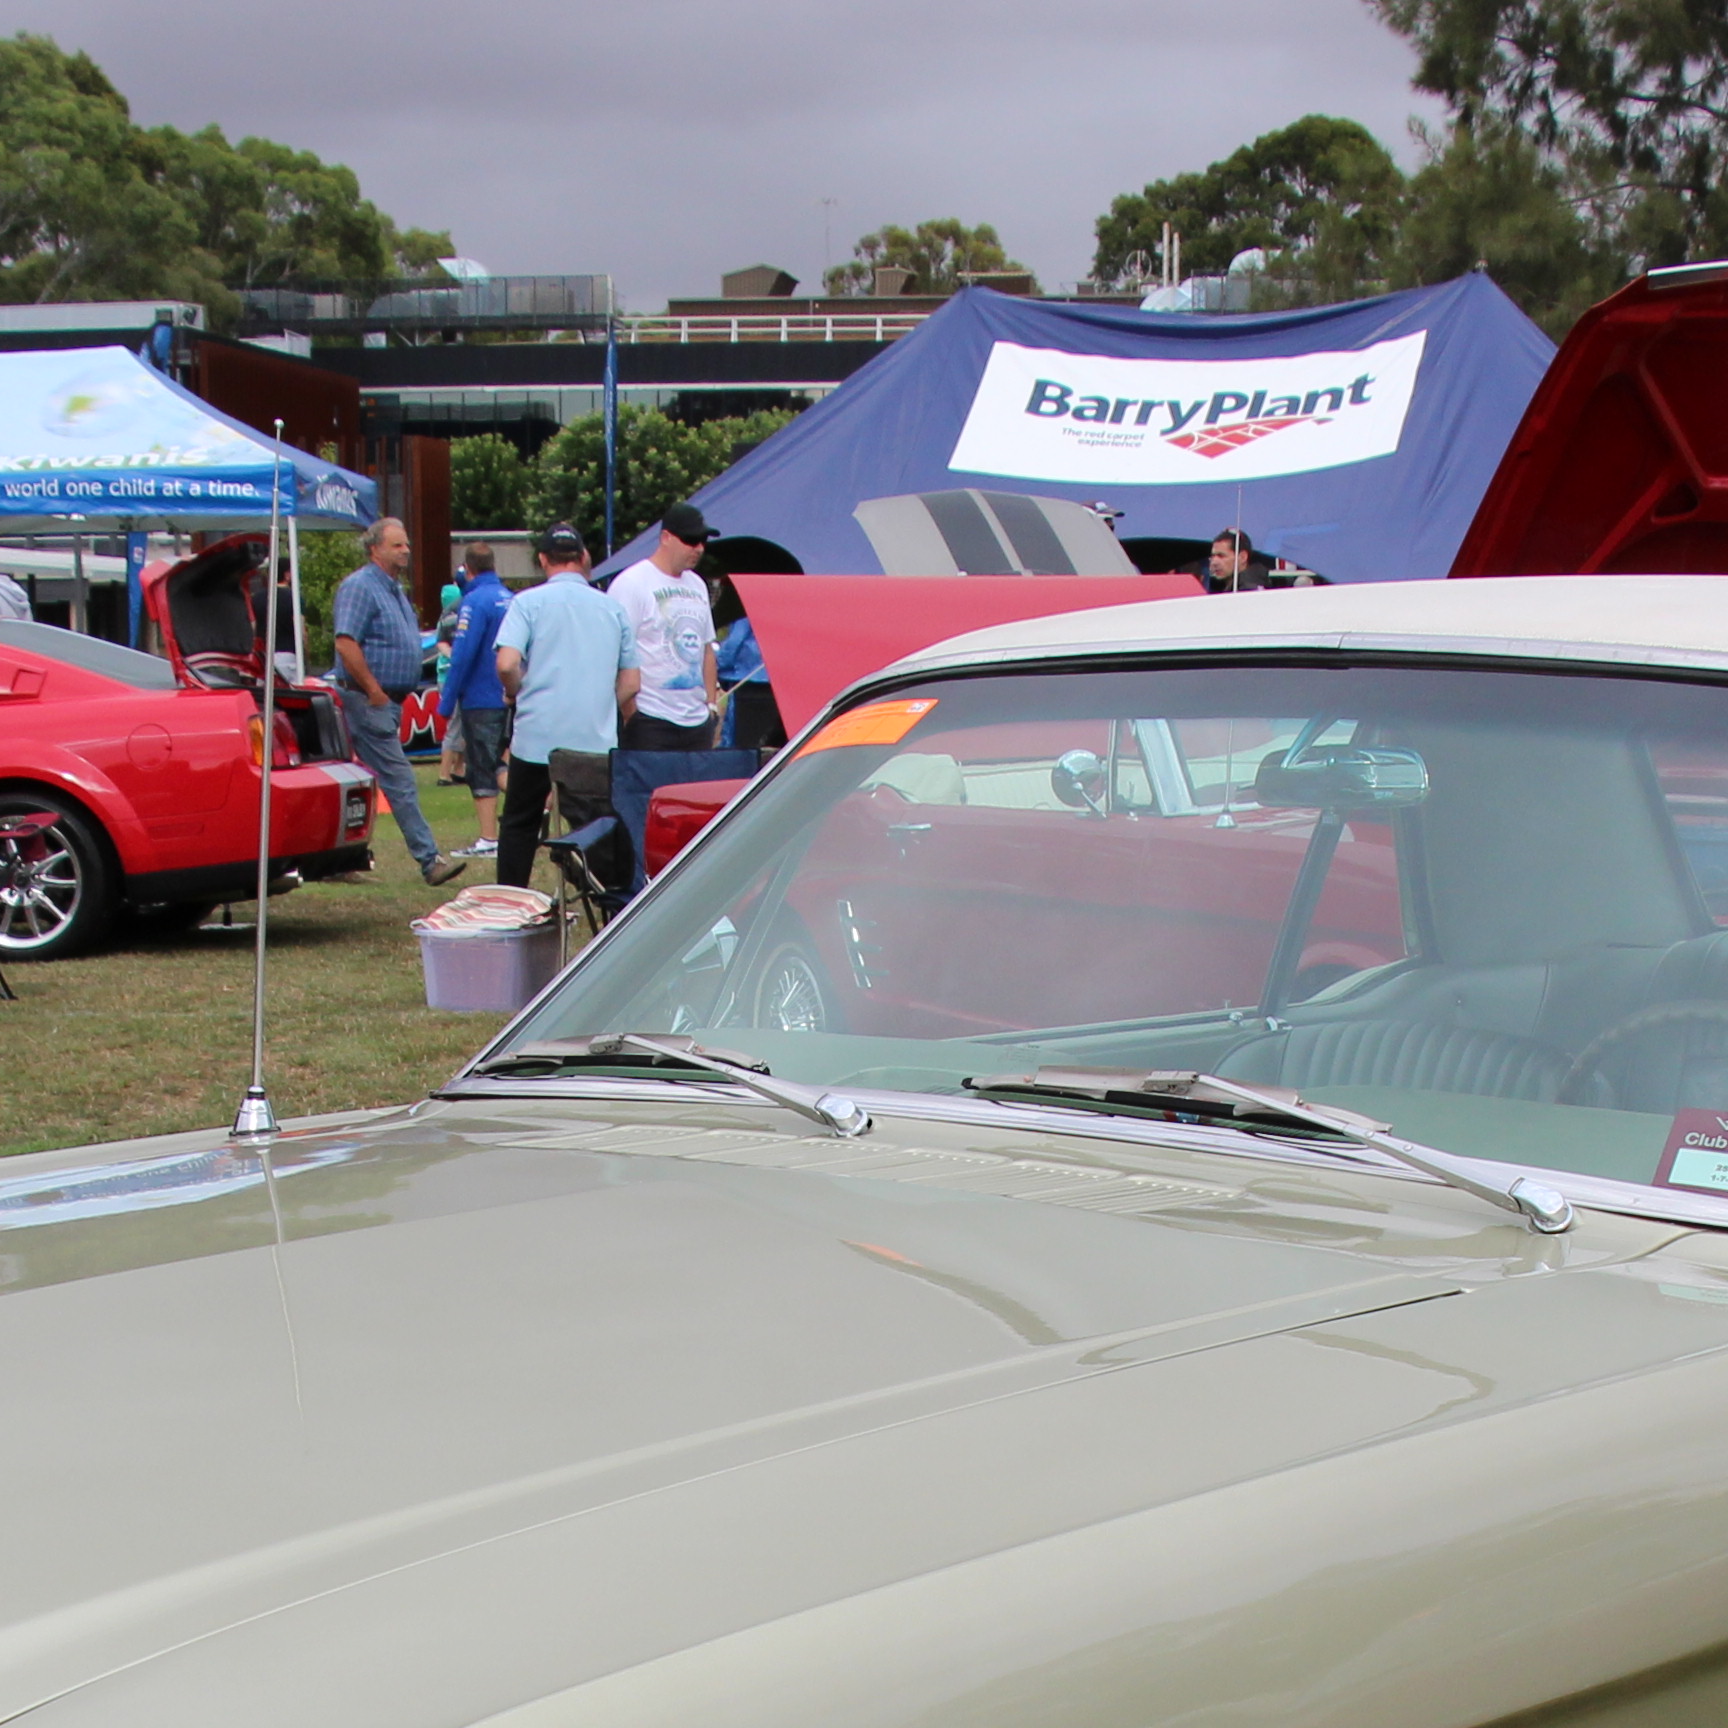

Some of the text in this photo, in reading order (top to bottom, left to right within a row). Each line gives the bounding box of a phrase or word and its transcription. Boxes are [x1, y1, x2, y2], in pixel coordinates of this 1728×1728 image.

[1062, 427, 1146, 444] The red carpet
[1077, 438, 1143, 449] experience
[4, 479, 60, 497] world
[65, 480, 103, 497] one
[109, 476, 156, 496] child
[162, 480, 183, 496] at
[188, 482, 202, 496] a
[208, 478, 260, 497] time.
[1684, 1131, 1728, 1149] Club
